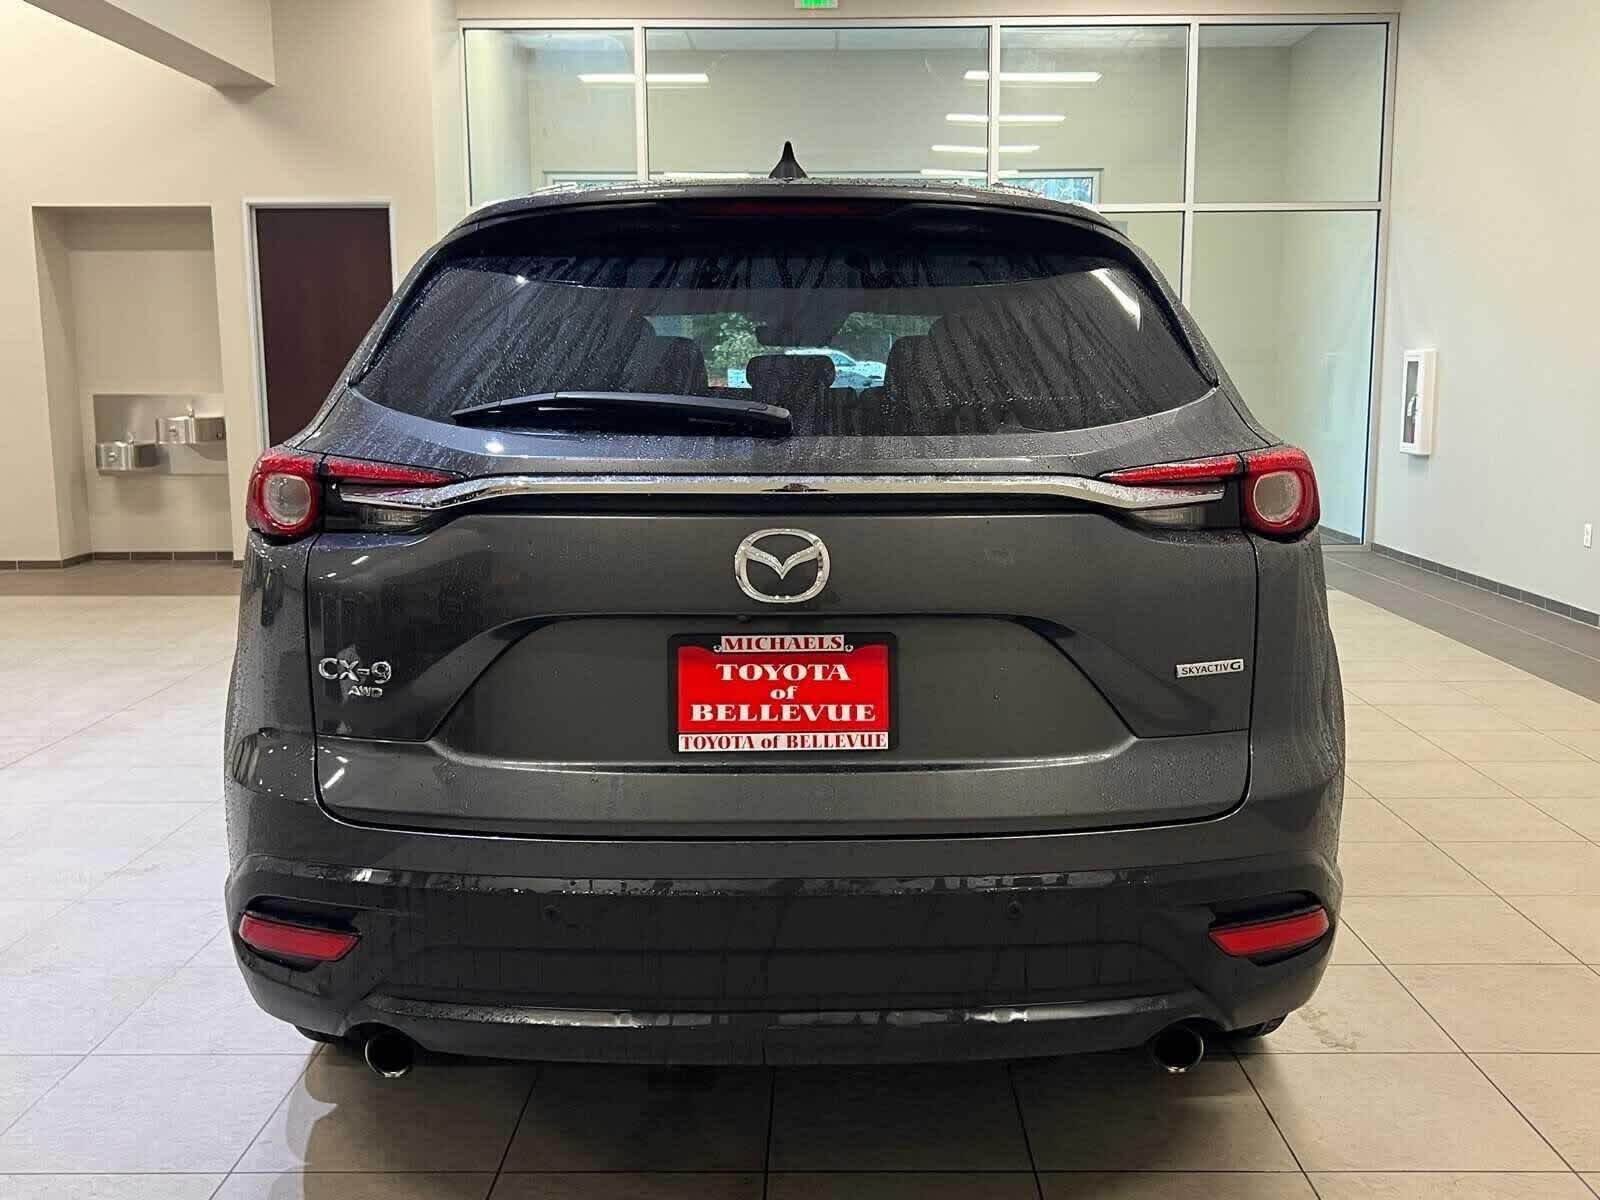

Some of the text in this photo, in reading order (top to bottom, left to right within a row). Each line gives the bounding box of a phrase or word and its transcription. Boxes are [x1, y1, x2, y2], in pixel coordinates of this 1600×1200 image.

[723, 636, 842, 651] MICHAELS
[318, 657, 392, 684] CX-9
[715, 663, 851, 681] TOYOTA
[348, 685, 383, 698] AWD
[770, 685, 798, 700] of
[690, 704, 876, 722] BELLEVUE
[680, 734, 887, 750] TOYOTA of BELLEVUE
